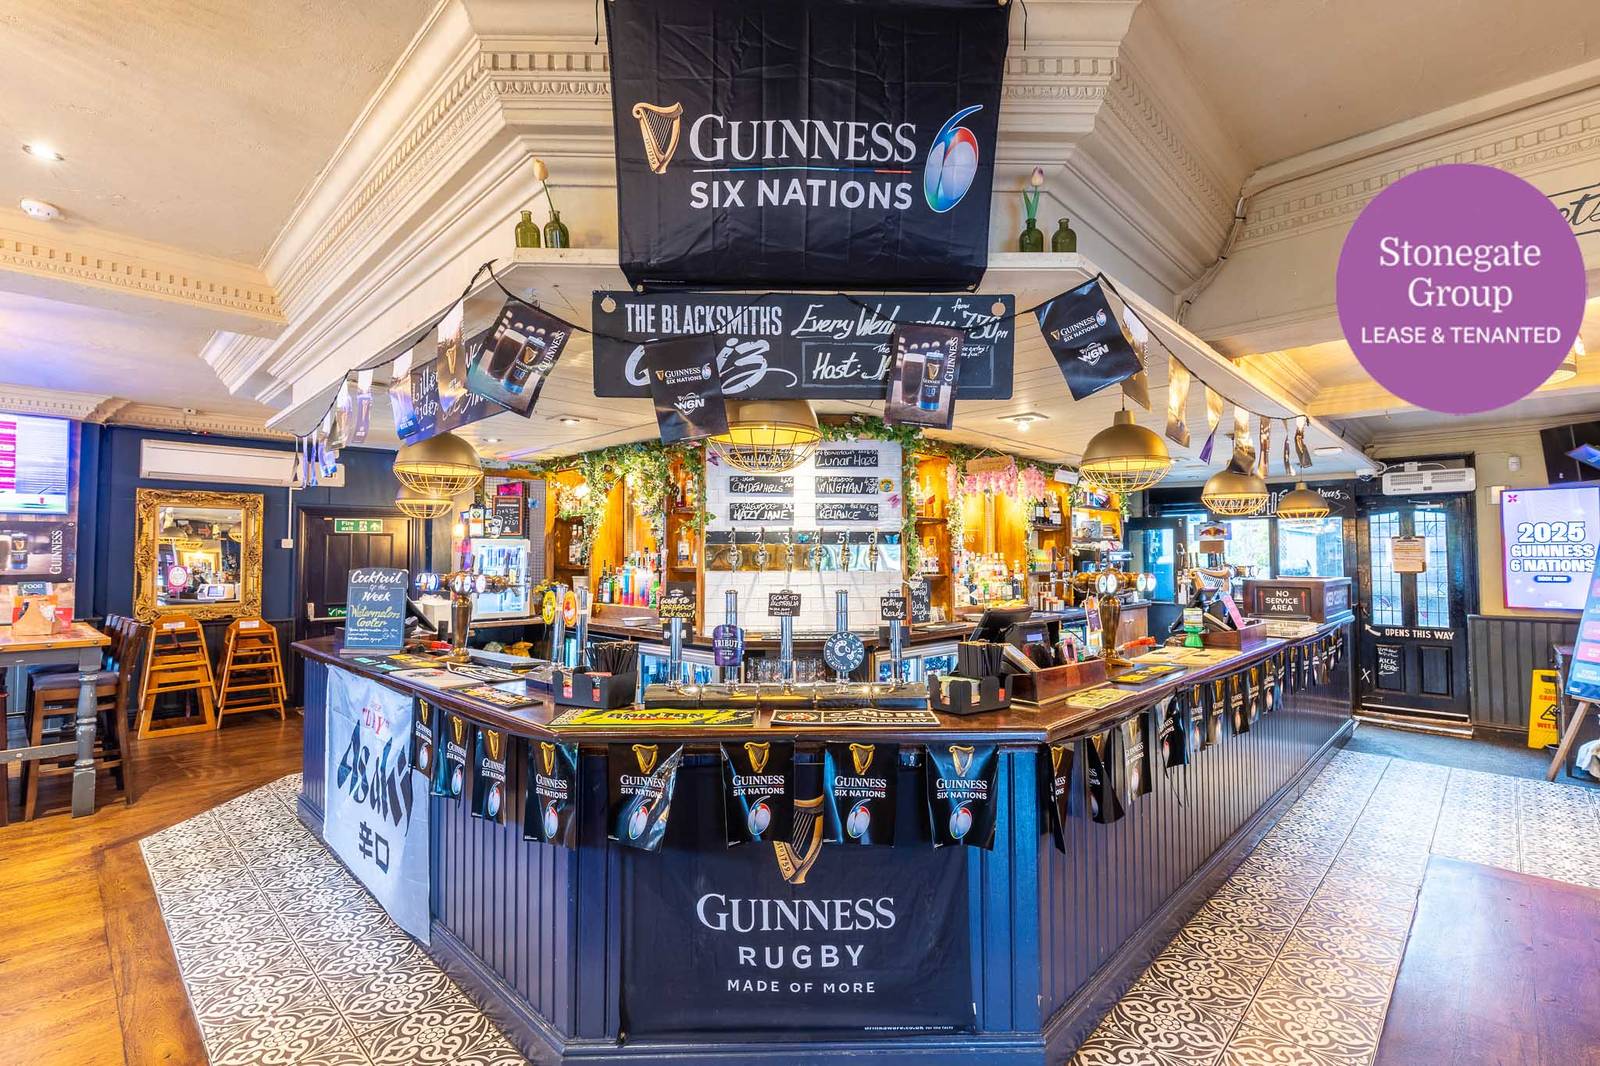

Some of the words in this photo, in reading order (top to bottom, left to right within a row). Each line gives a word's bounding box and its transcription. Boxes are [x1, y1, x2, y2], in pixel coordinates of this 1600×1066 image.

[689, 114, 917, 163] GUINNESS
[689, 181, 745, 209] SIX
[757, 179, 913, 210] NATIONS
[625, 303, 656, 333] THE
[661, 304, 782, 336] BLACKSMITHS
[791, 304, 855, 340] Every
[1060, 316, 1096, 336] GUINNESS
[1073, 323, 1099, 338] NATIONS
[538, 330, 566, 371] GUINNESS
[1078, 344, 1109, 362] W6N
[944, 336, 959, 382] GUINNESS
[665, 367, 701, 378] GUINNESS
[812, 352, 862, 380] Host:
[677, 375, 702, 383] NATIONS
[674, 398, 705, 410] W6N
[816, 455, 853, 467] Lunar
[853, 454, 877, 466] Haze
[732, 482, 763, 493] CAMDEN
[817, 480, 864, 494] WINGMAN
[734, 509, 760, 520] HAZY
[760, 510, 790, 520] JANE
[820, 508, 861, 520] RELIANCE
[755, 533, 762, 544] 2
[782, 533, 790, 543] 3
[812, 534, 819, 543] 4
[838, 533, 846, 543] 5
[868, 534, 875, 543] 6
[1518, 521, 1586, 543] 2025
[49, 529, 63, 575] GUINNESS
[1510, 543, 1595, 558] GUINNESS
[1510, 559, 1521, 572] 6
[1523, 559, 1596, 573] NATIONS
[351, 570, 403, 584] Cocktail
[362, 592, 391, 601] Week
[1265, 597, 1299, 605] SERVICE
[1270, 604, 1294, 612] AREA
[1385, 628, 1410, 637] OPENS
[1412, 630, 1431, 638] THIS
[1434, 631, 1454, 640] WAY
[714, 639, 743, 649] TRIBUTE
[827, 632, 854, 647] BLACK
[849, 641, 863, 669] SHEEP
[830, 709, 926, 718] CAMDEN
[536, 774, 567, 790] GUINNESS
[620, 774, 665, 789] GUINNESS
[732, 774, 785, 787] GUINNESS
[834, 776, 887, 789] GUINNESS
[936, 778, 988, 790] GUINNESS
[536, 787, 549, 796] SIX
[549, 788, 568, 800] NATIONS
[620, 787, 634, 795] SIX
[635, 788, 663, 799] NATIONS
[733, 788, 747, 797] SIX
[748, 786, 785, 796] NATIONS
[834, 790, 848, 798] SIX
[850, 789, 886, 799] NATIONS
[936, 791, 950, 799] SIX
[951, 790, 987, 799] NATIONS
[696, 892, 896, 932] GUINNESS
[738, 944, 865, 969] RUGBY
[727, 979, 780, 993] MADE
[790, 982, 814, 993] OF
[823, 981, 876, 994] MORE
